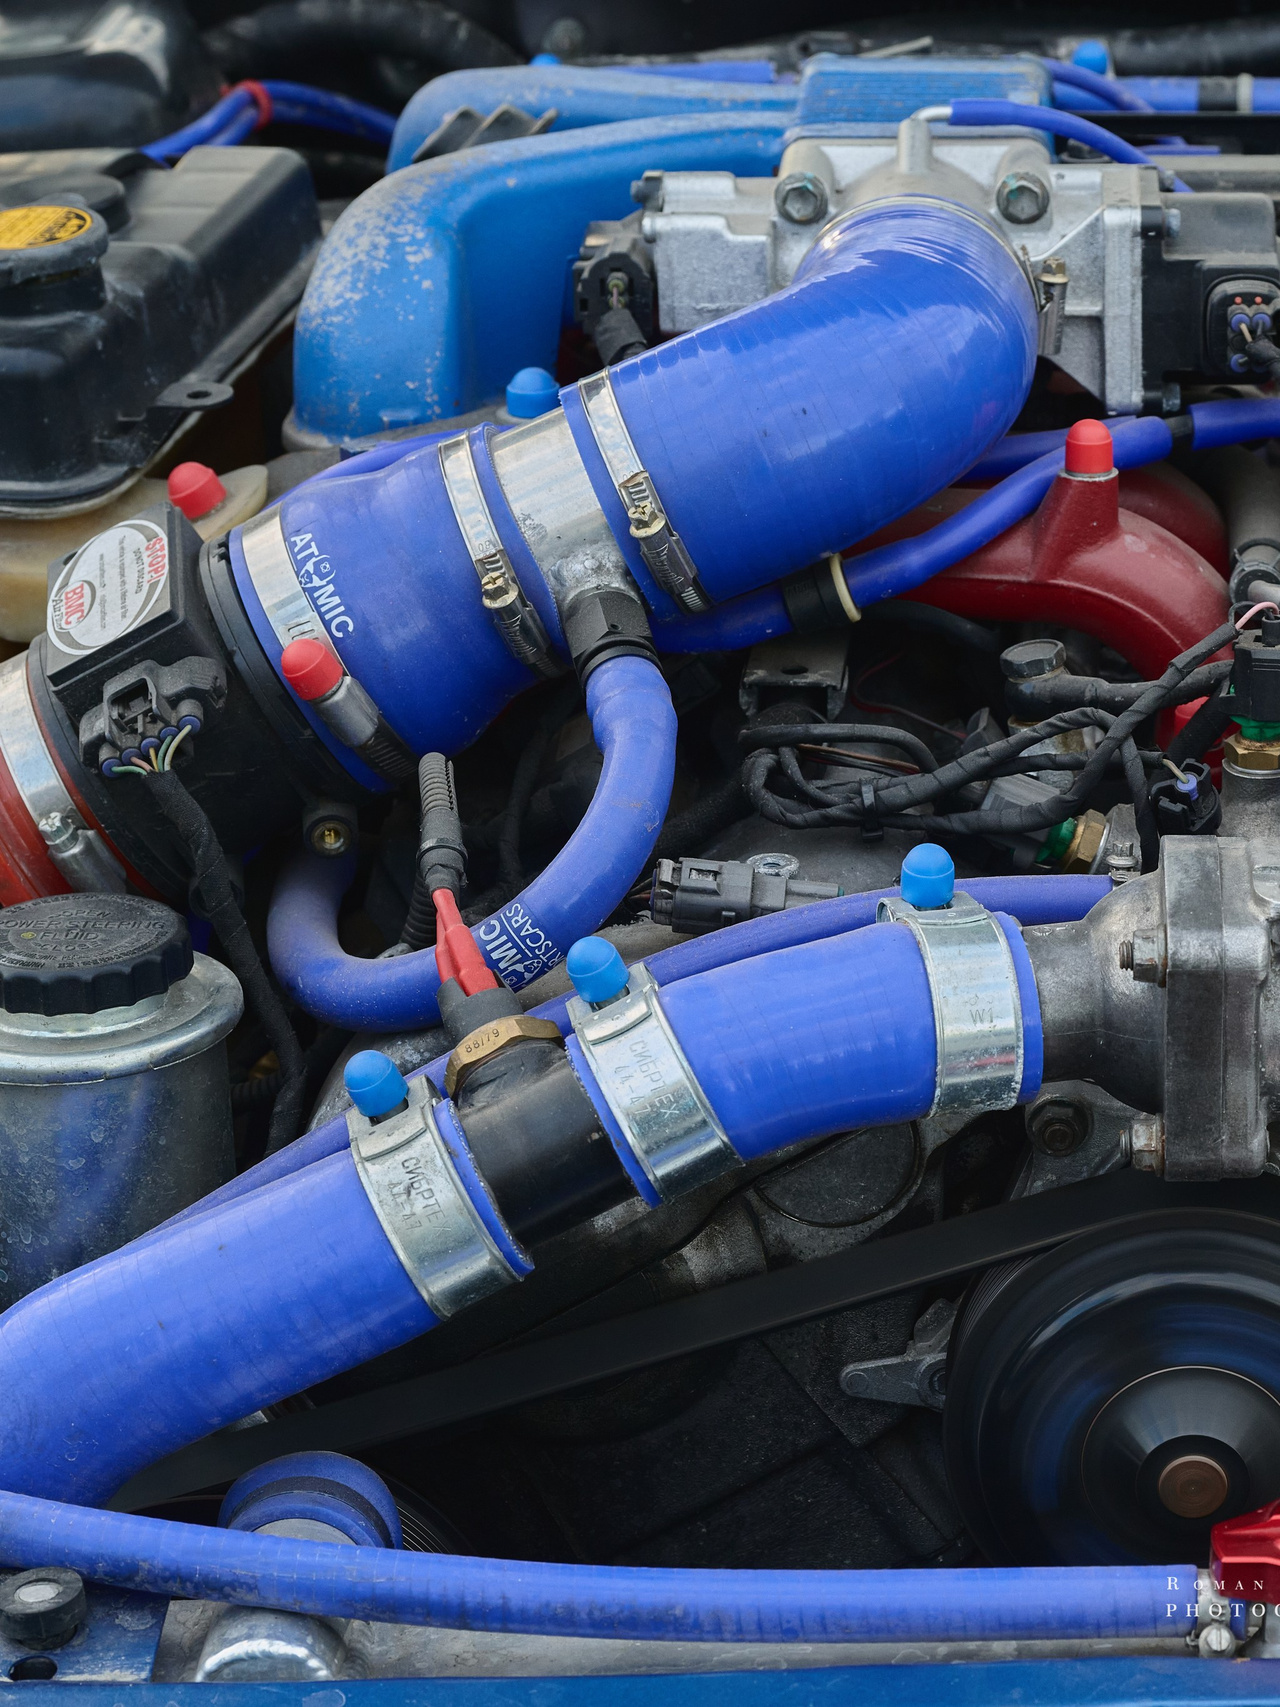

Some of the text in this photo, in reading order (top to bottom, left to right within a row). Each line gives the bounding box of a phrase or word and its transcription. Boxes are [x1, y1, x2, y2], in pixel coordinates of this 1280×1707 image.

[145, 537, 166, 584] STOP!
[64, 581, 85, 626] BMC
[40, 930, 99, 940] FLUID
[65, 919, 166, 930] STEERING
